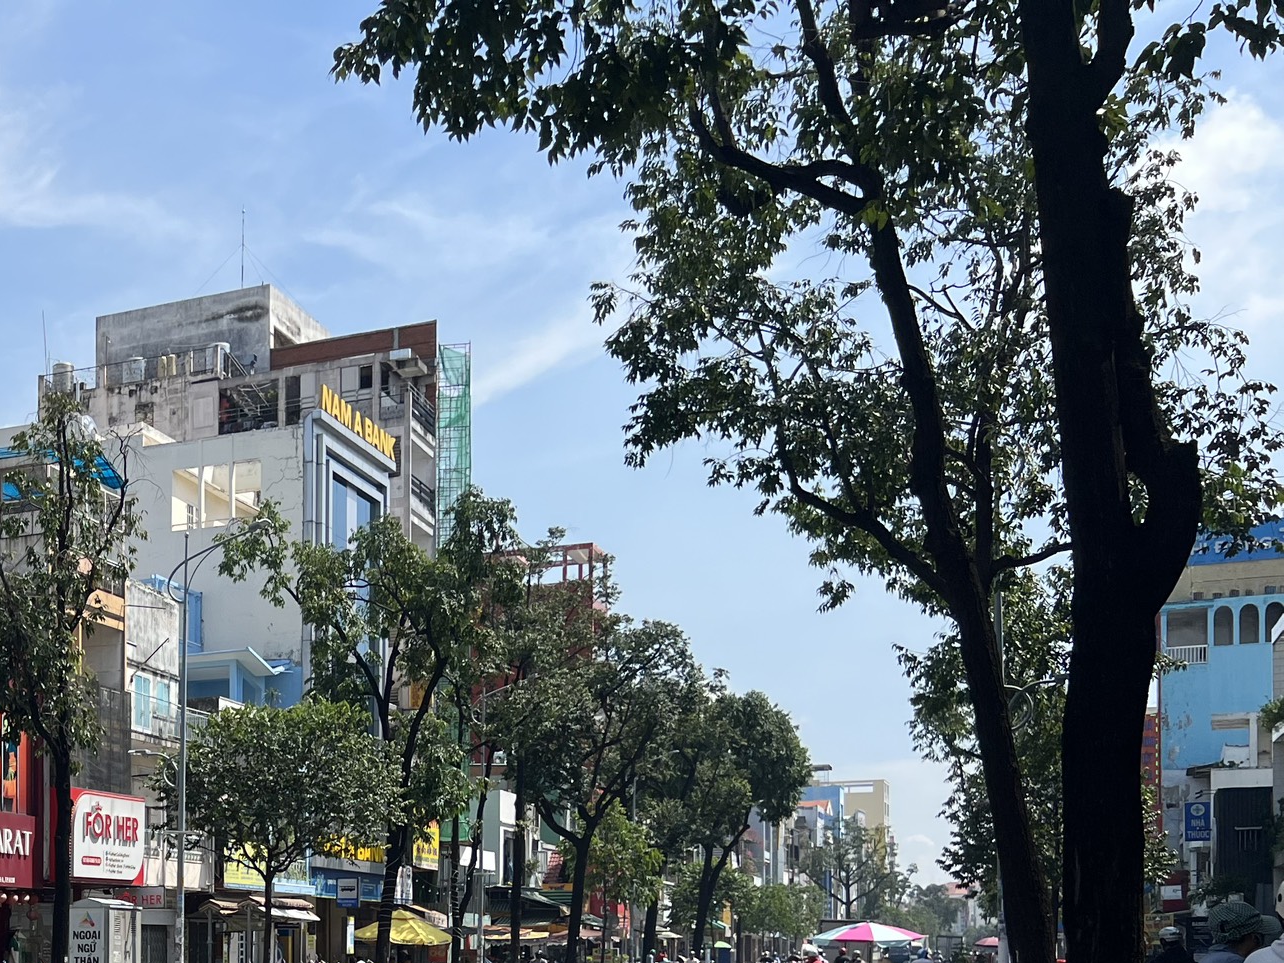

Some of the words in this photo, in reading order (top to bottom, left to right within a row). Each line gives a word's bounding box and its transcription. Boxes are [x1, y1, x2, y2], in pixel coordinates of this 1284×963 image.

[322, 383, 352, 430] NAM
[354, 410, 363, 438] A
[365, 416, 396, 461] BANK
[85, 811, 112, 839] FOR
[117, 816, 139, 842] HER
[141, 894, 162, 905] HER
[72, 930, 101, 942] NGOẠI
[77, 941, 97, 953] NGỮ
